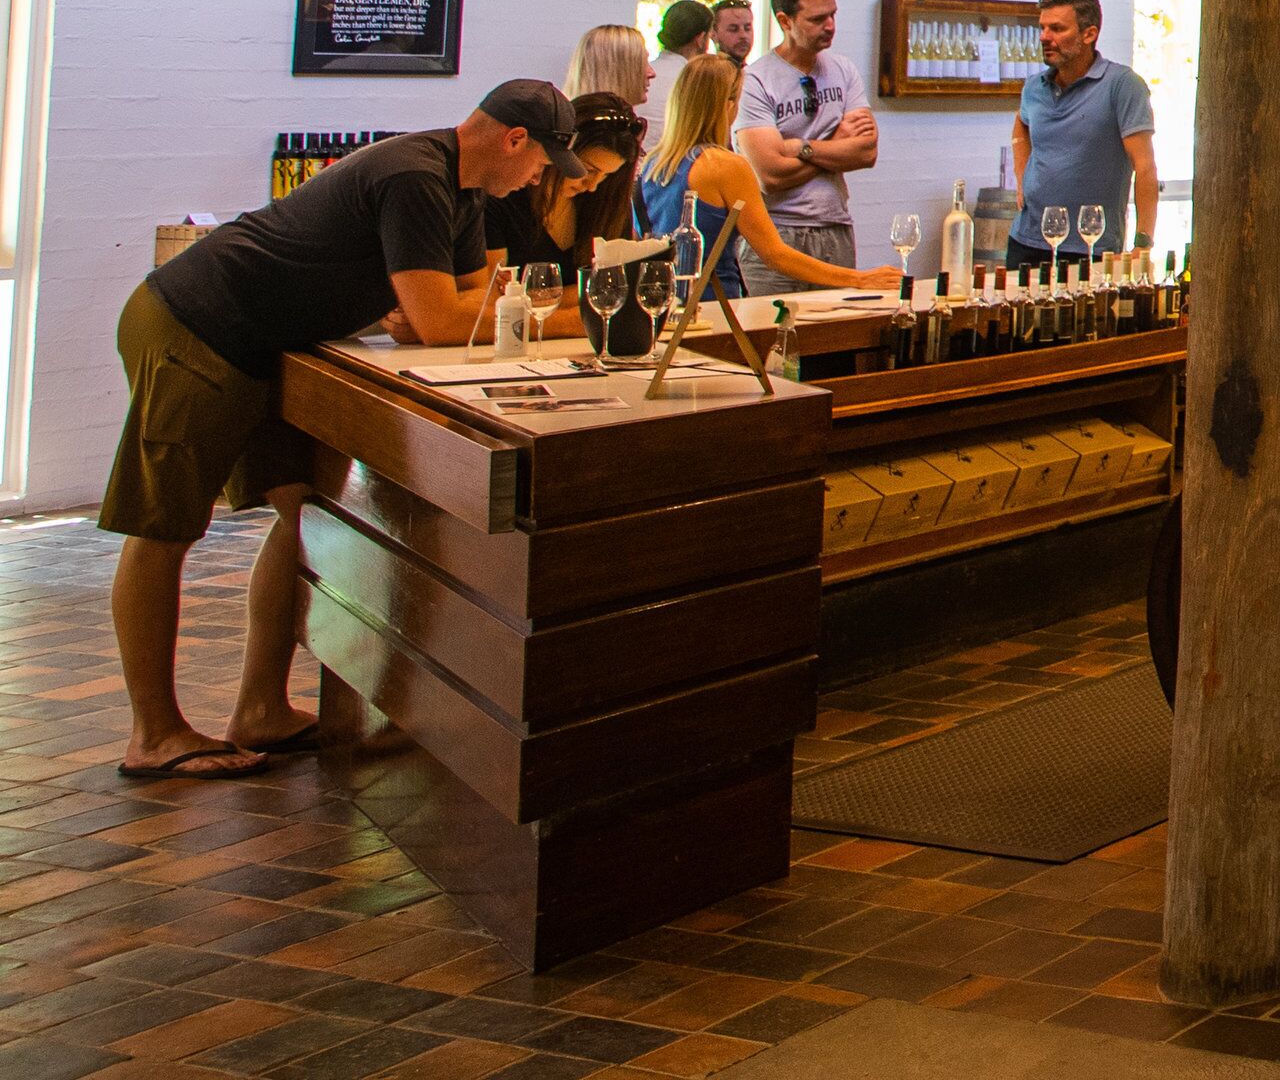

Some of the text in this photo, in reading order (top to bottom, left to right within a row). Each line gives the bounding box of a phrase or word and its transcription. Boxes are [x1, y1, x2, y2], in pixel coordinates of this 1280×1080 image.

[356, 6, 375, 14] deeper
[372, 14, 386, 22] gold
[404, 14, 417, 22] first
[776, 87, 843, 120] BARDEUR
